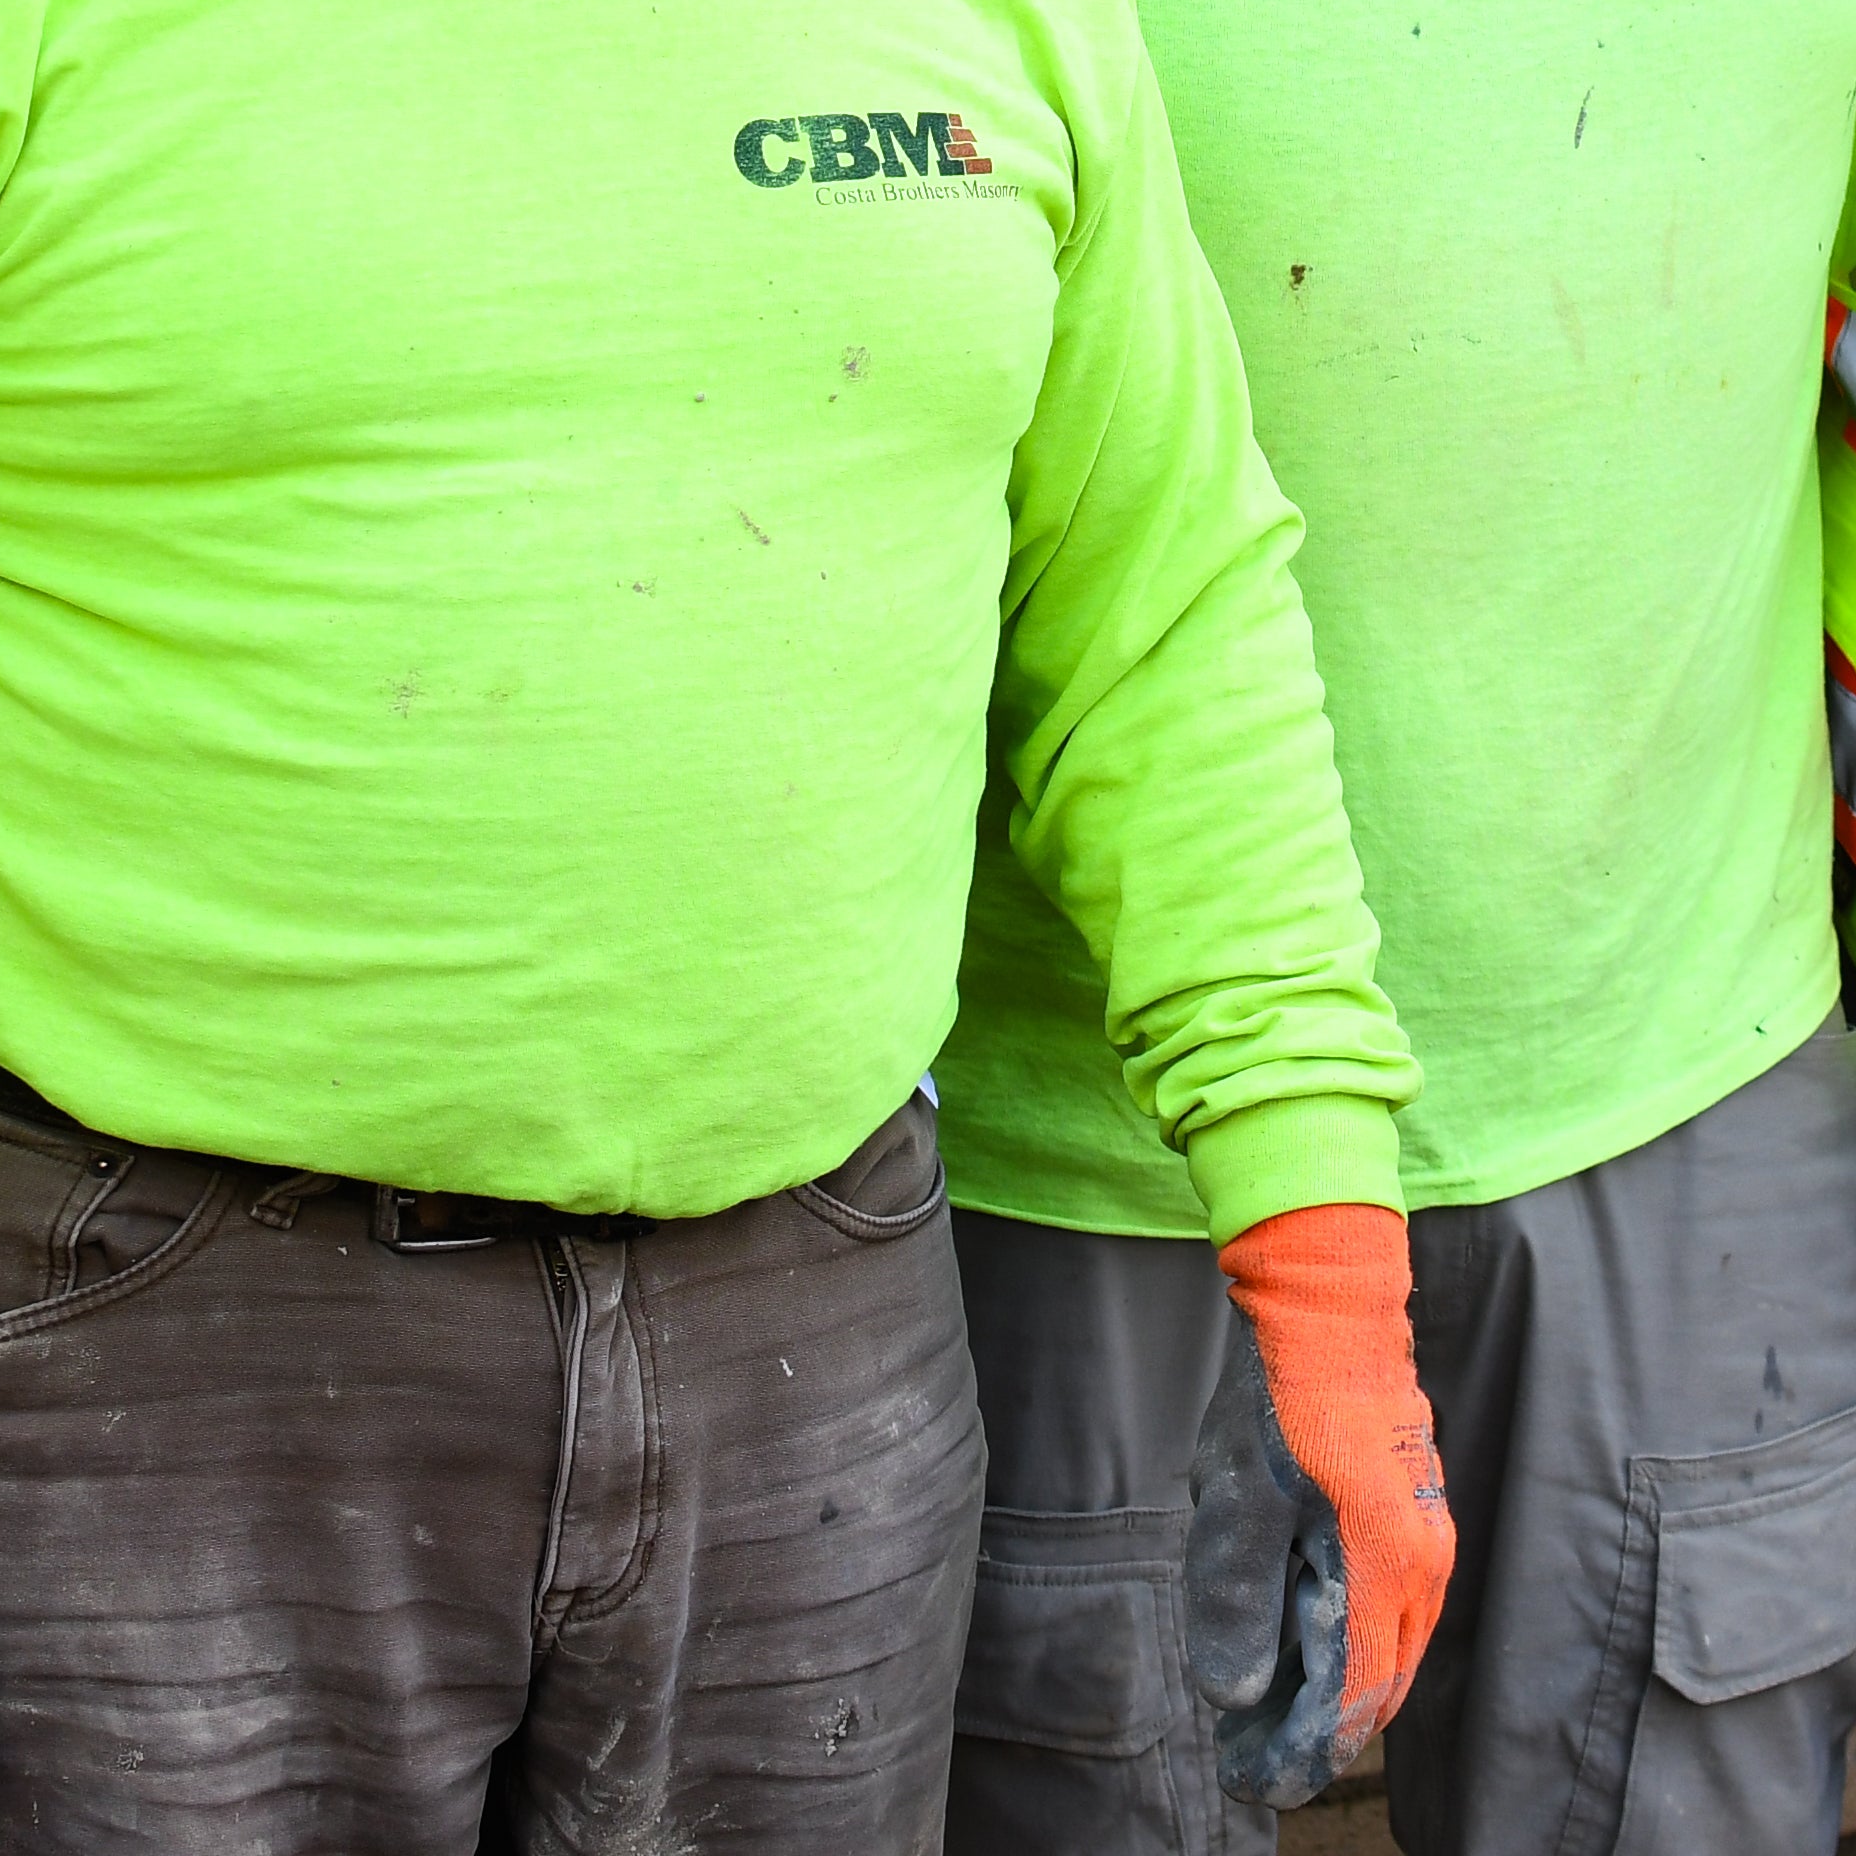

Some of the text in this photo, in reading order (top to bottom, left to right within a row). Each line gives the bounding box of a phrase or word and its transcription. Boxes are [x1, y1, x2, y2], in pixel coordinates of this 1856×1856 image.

[734, 112, 966, 189] CBM
[816, 180, 1022, 206] Costa Brothers Masonry
